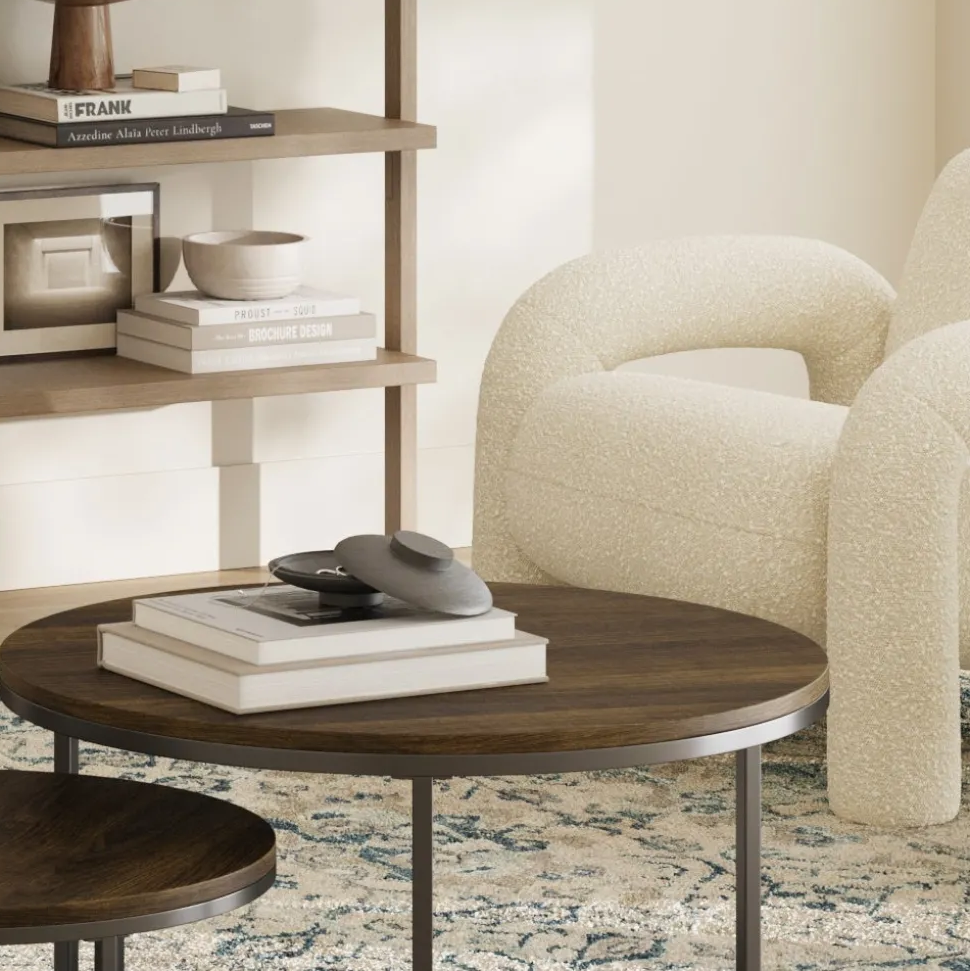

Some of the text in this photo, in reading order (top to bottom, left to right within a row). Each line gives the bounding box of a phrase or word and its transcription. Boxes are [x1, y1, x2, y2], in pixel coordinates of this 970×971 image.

[75, 99, 132, 117] FRANK
[67, 129, 112, 142] Azzedine
[145, 126, 170, 138] Peter
[173, 122, 223, 136] Lindbergh
[234, 309, 271, 321] PROUST
[248, 326, 299, 343] BROCHURE
[299, 323, 333, 339] DESIGN
